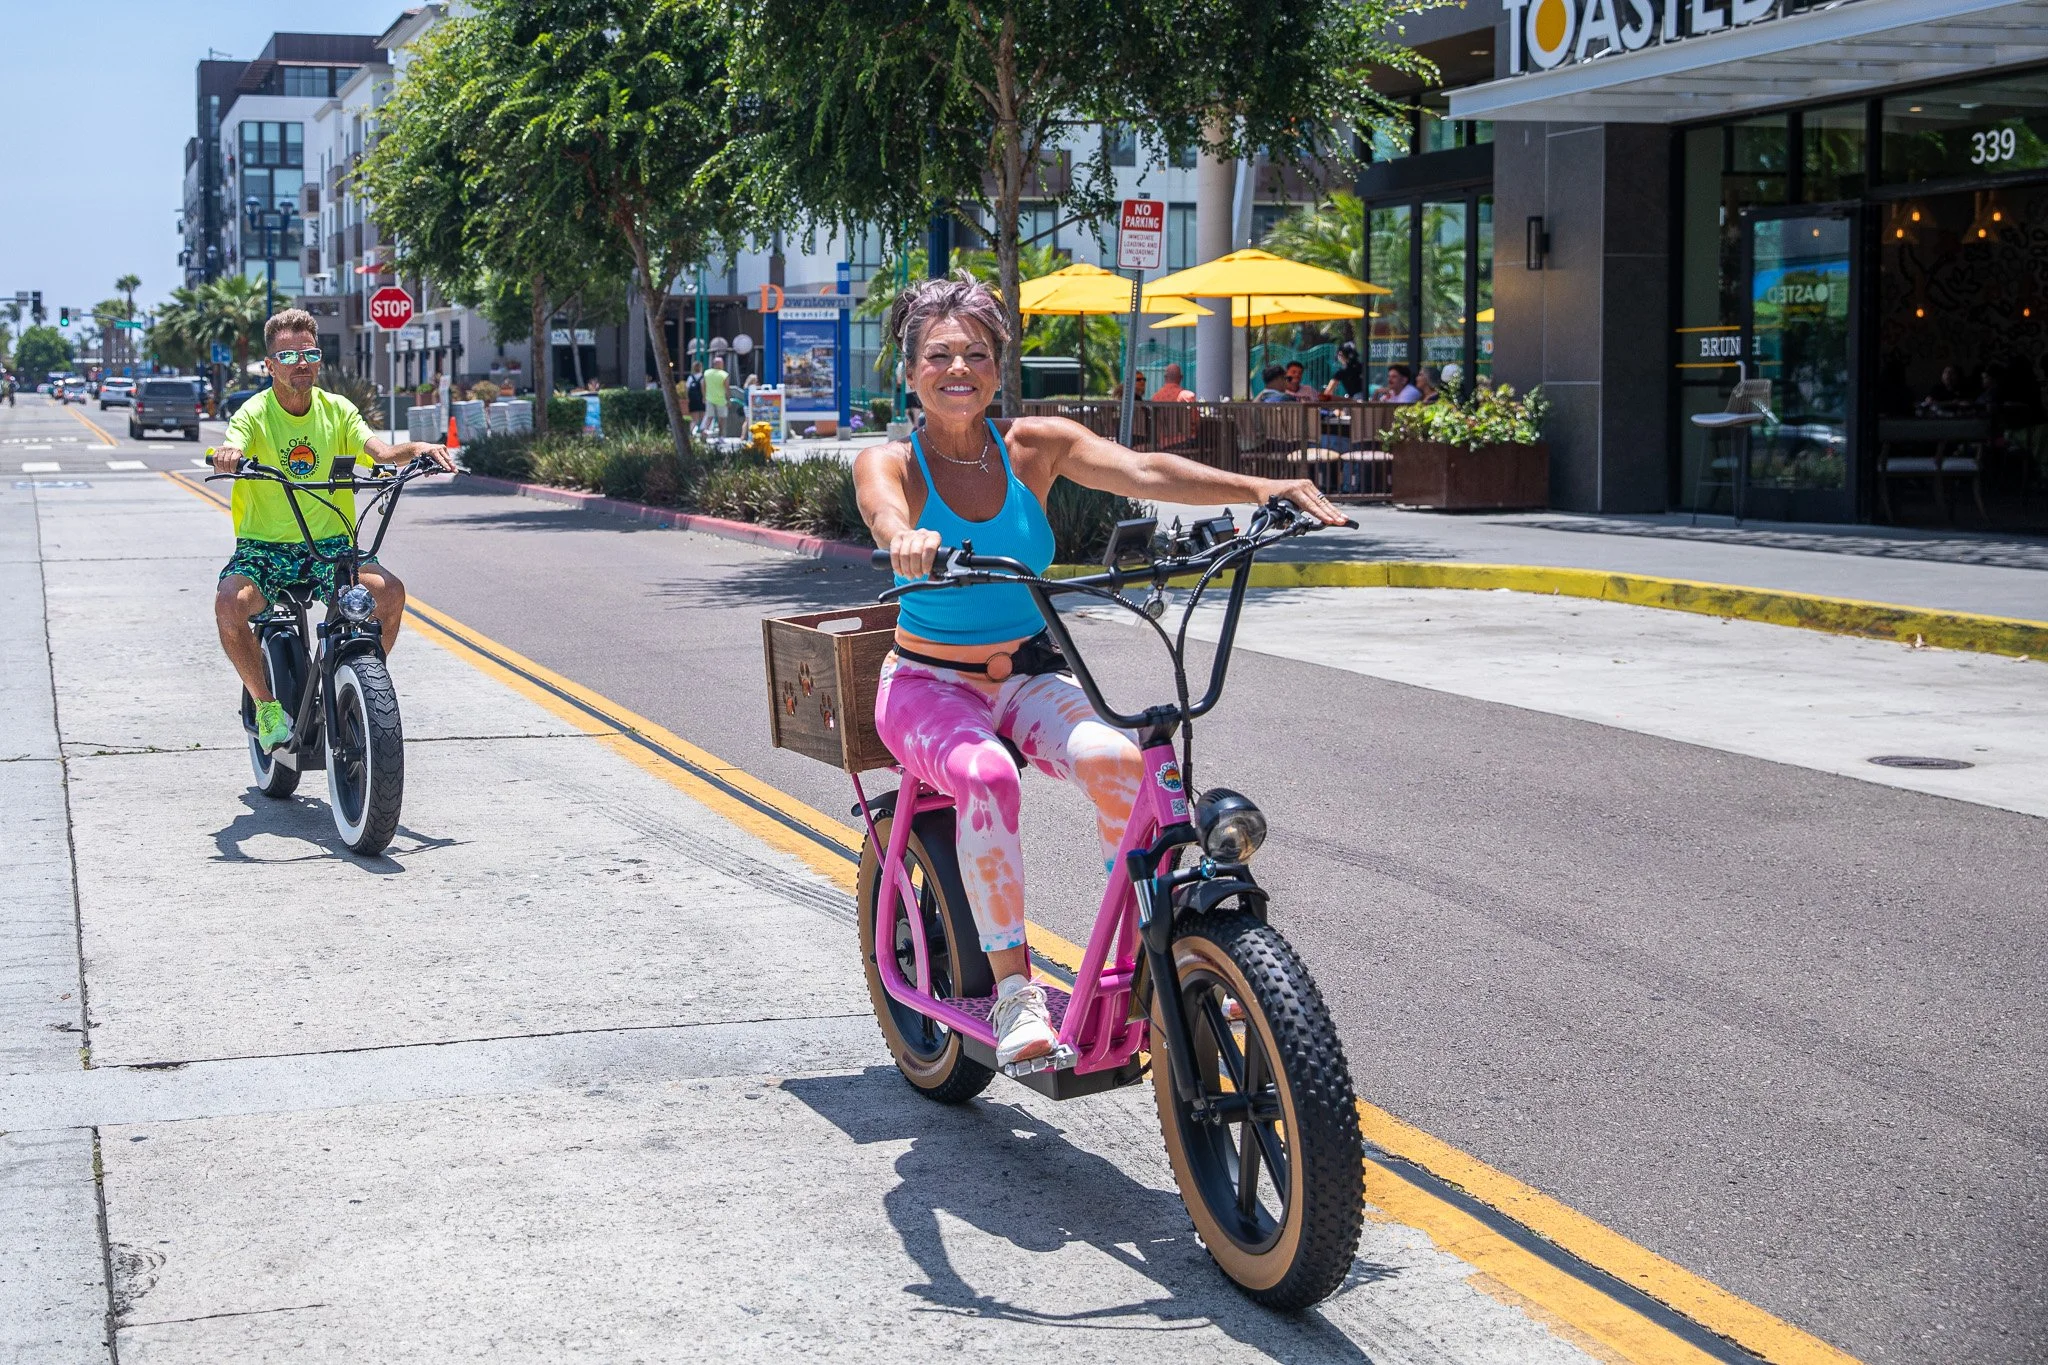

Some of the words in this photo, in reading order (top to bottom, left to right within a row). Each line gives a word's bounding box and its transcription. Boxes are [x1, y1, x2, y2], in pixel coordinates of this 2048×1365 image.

[1971, 128, 2015, 164] 339
[1135, 204, 1151, 216] NO
[1125, 216, 1159, 229] PARKING
[373, 300, 410, 318] STOP
[783, 311, 834, 319] oceanside
